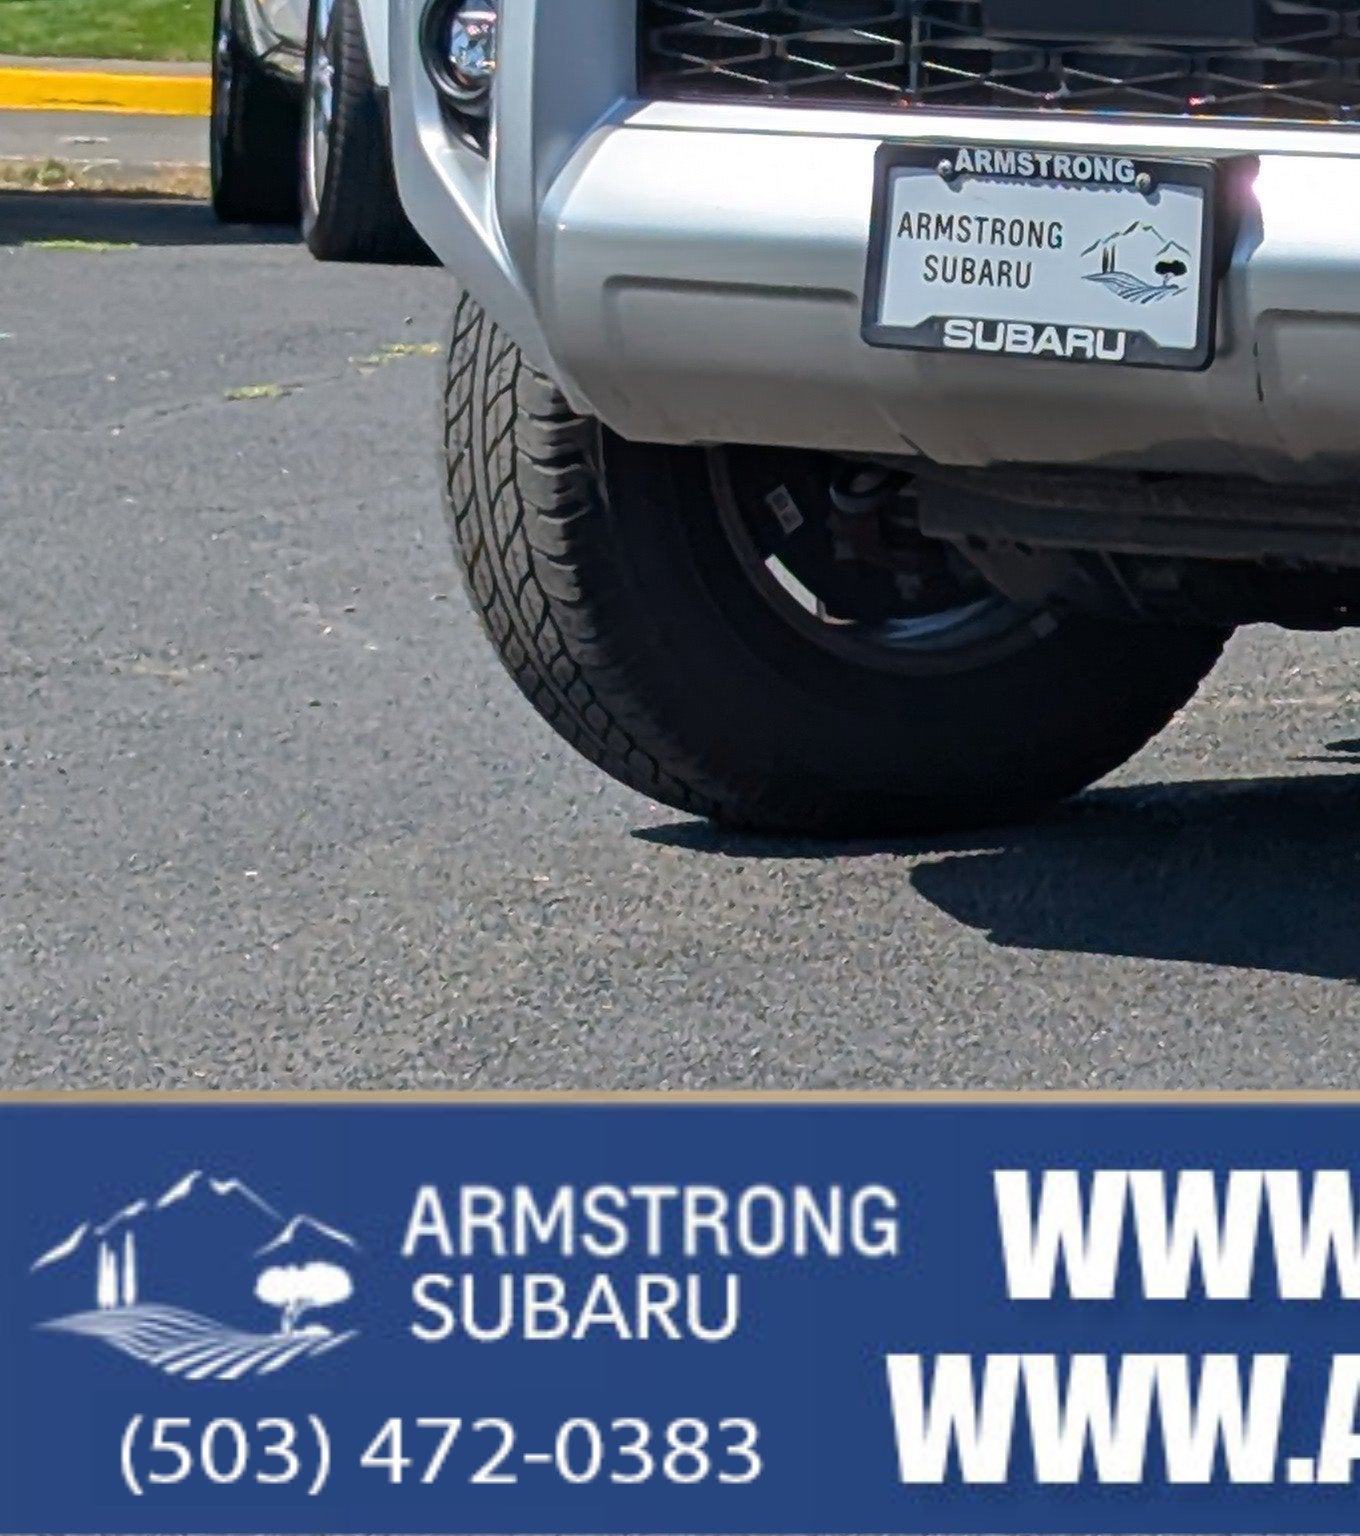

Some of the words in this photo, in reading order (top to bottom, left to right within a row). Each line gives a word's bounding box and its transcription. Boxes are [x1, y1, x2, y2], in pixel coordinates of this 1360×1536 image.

[953, 148, 1136, 183] ARMSTRONG
[898, 210, 1064, 249] ARMSTRONG
[923, 254, 1032, 289] SUBARU
[942, 319, 1126, 361] SUBARU
